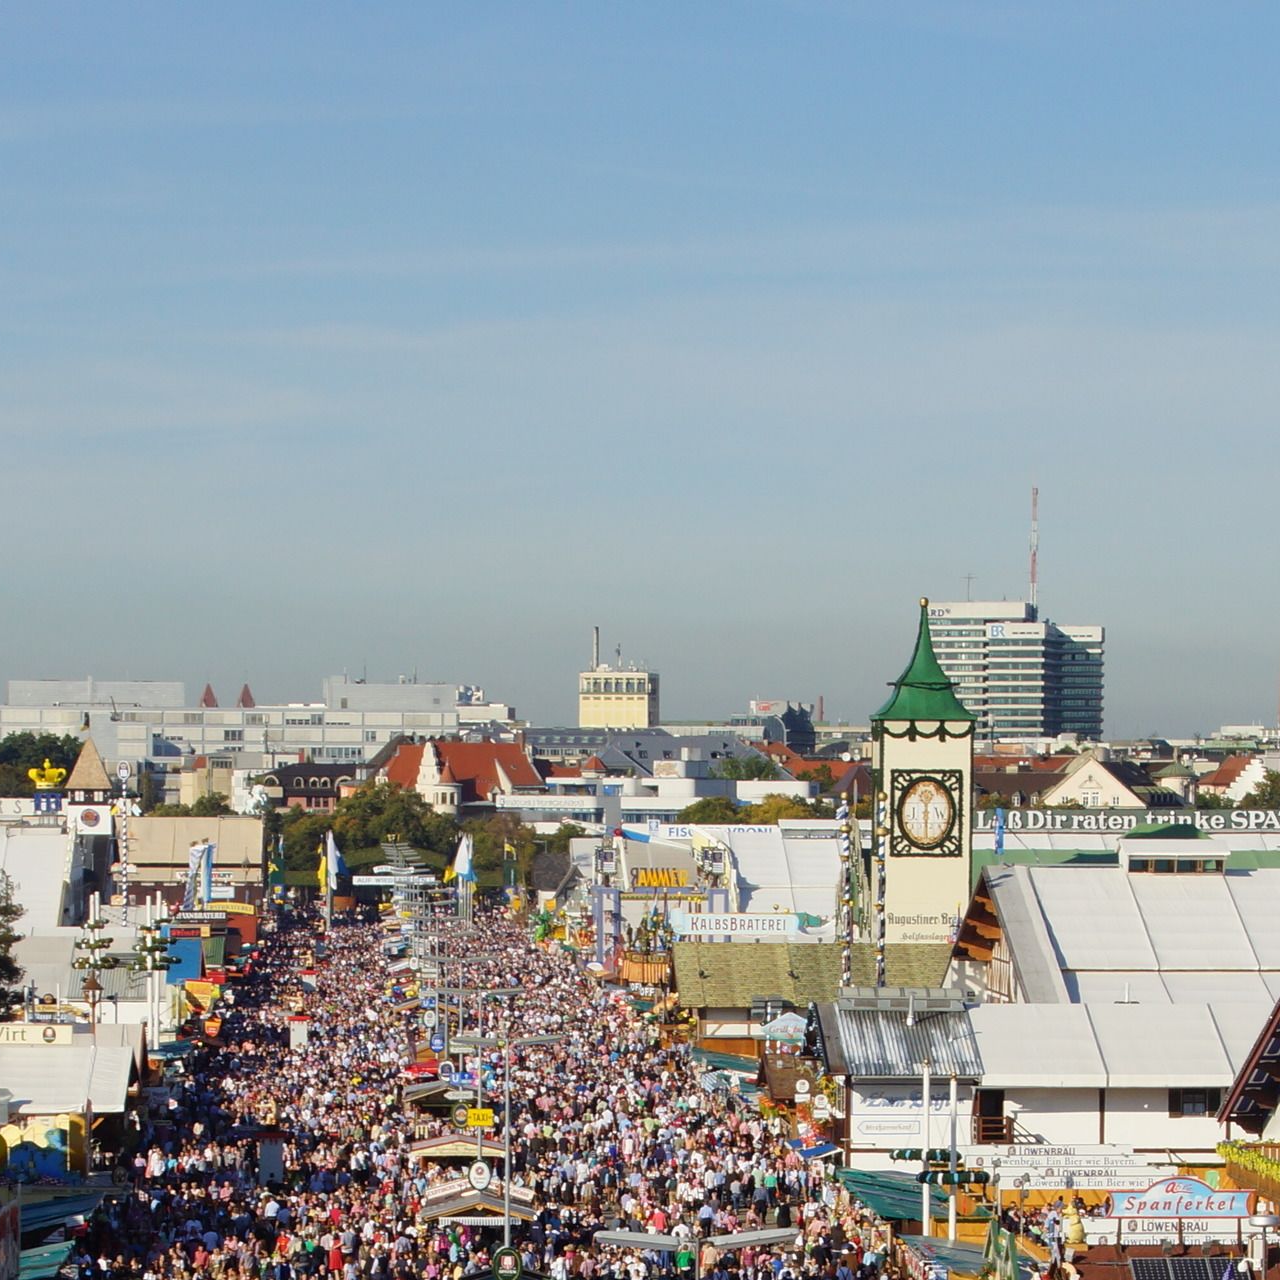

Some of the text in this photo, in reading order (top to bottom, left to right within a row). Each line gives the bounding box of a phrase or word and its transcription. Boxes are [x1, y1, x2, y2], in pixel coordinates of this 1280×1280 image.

[1026, 811, 1068, 829] Dir
[887, 912, 938, 928] Augustiner
[472, 1113, 489, 1122] TAXI
[1046, 1157, 1063, 1166] Ein
[1065, 1157, 1082, 1166] Bier
[1085, 1157, 1100, 1166] wie
[1102, 1157, 1137, 1168] Bayern.
[1087, 1178, 1104, 1188] Ein
[1106, 1178, 1125, 1188] Bier
[1127, 1178, 1145, 1188] wie
[1125, 1196, 1236, 1217] Spanferkel
